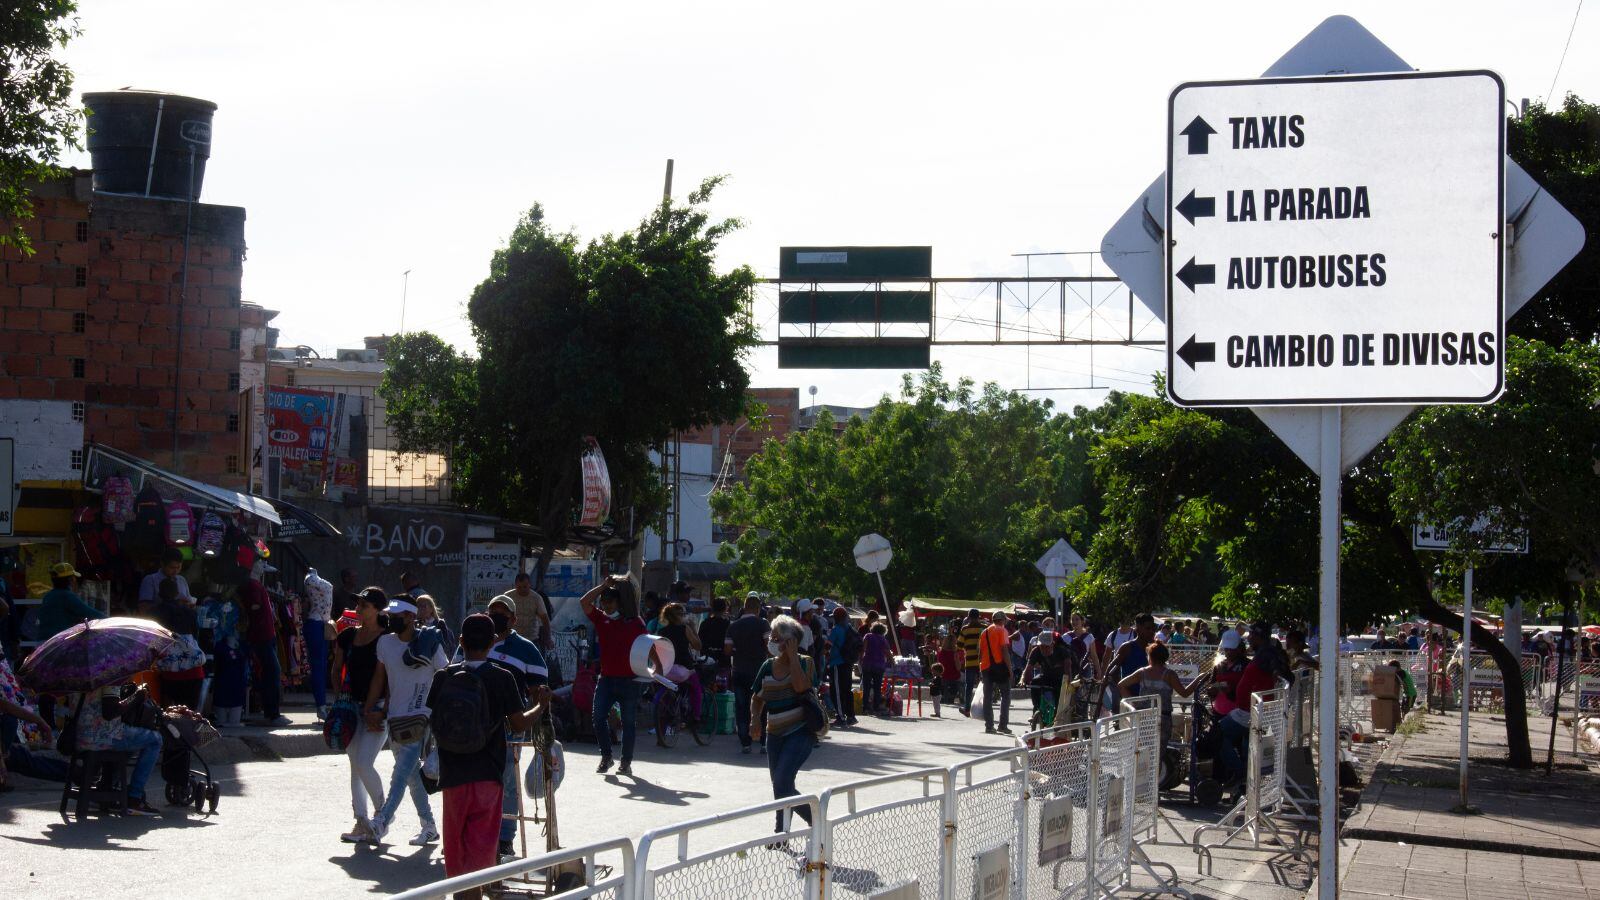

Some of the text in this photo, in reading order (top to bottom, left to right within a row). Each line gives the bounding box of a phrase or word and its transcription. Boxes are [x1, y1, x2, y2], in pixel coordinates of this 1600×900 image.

[1228, 114, 1305, 149] TAXIS
[1226, 186, 1370, 222] LA PARADA
[1227, 253, 1387, 289] AUTOBUSES
[1228, 332, 1497, 368] CAMBIO DE DIVISAS
[365, 518, 445, 553] BAÑO
[469, 553, 517, 561] TECNICO
